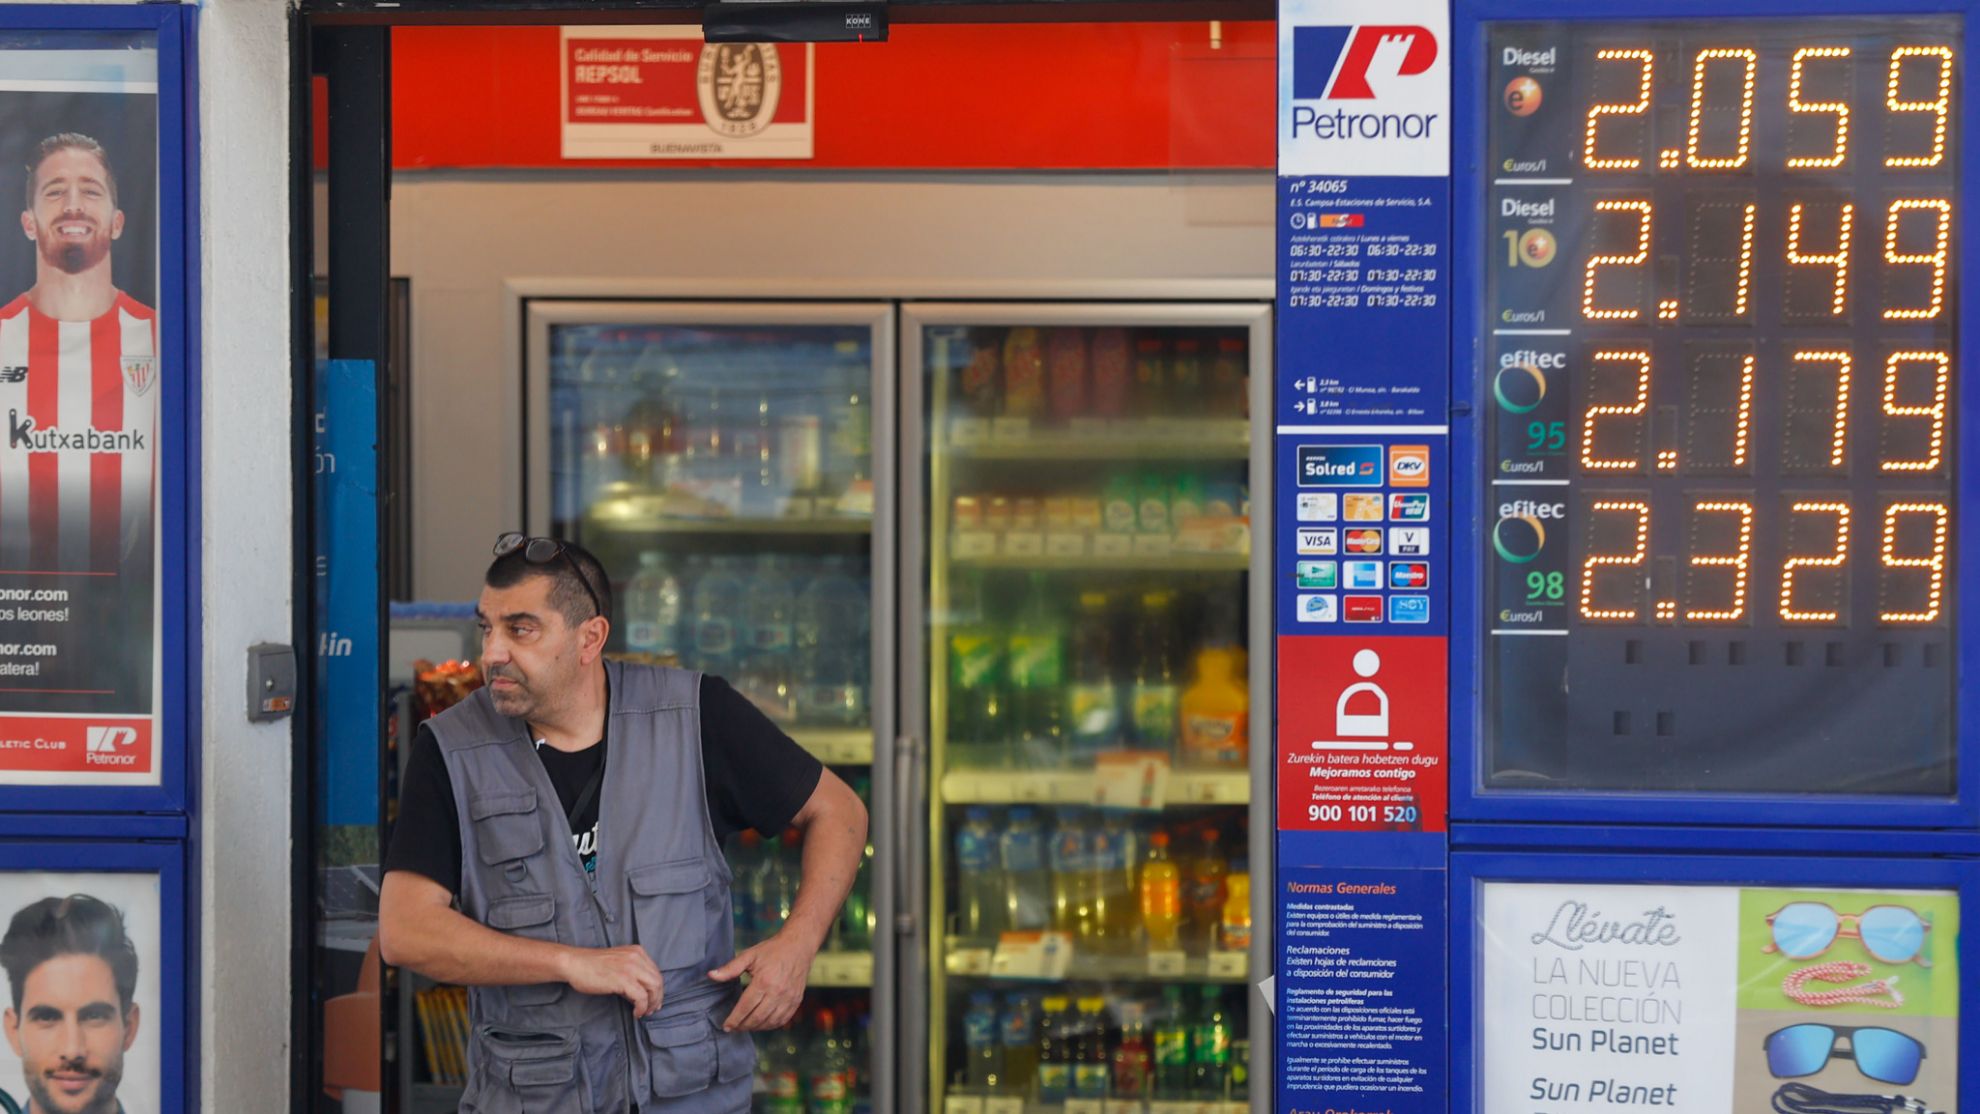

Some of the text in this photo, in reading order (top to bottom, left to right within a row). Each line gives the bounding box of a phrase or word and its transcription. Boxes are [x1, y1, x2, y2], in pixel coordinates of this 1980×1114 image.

[846, 17, 870, 25] KONE
[574, 47, 693, 62] Calidad de Servicio
[1503, 47, 1556, 65] Diesel
[575, 65, 643, 84] REPSOL
[1584, 46, 1952, 168] 2.059
[1291, 106, 1438, 139] Petronor
[1307, 180, 1348, 193] 34065
[1501, 197, 1555, 217] Diesel
[1582, 199, 1951, 319] 2.149
[1499, 350, 1567, 369] efitec
[1581, 351, 1949, 471] 2.179
[9, 408, 145, 450] Kutxabank
[1527, 421, 1567, 449] 95
[1305, 461, 1356, 476] Solred
[1397, 461, 1423, 471] DKV
[1498, 500, 1566, 519] efitec
[1304, 535, 1332, 547] VISA
[1580, 502, 1948, 622] 2.329
[1526, 571, 1565, 600] 98
[17, 606, 69, 622] leones!
[86, 752, 137, 764] Petronor
[1287, 753, 1439, 768] Zurekin batera hobetzen dugu
[1309, 766, 1416, 780] Mejoramos contigo
[1312, 793, 1342, 801] Teléfono
[1342, 793, 1352, 801] de
[1352, 793, 1382, 802] atención
[1383, 794, 1391, 802] al
[1308, 804, 1417, 823] 900 101 520
[1287, 882, 1397, 895] Normas Generales
[1286, 902, 1354, 911] Medidas contrastadas
[1531, 900, 1682, 951] Llévate
[1286, 945, 1350, 956] Reclamaciones
[1286, 957, 1313, 966] Existen
[1314, 957, 1335, 968] hojas
[1336, 957, 1347, 967] de
[1293, 968, 1395, 979] disposición del consumidor
[1533, 957, 1681, 989] LA NUEVA
[1286, 987, 1325, 997] Reglamento
[1325, 988, 1335, 996] de
[1335, 988, 1367, 998] seguridad
[1367, 990, 1383, 999] para
[1532, 991, 1682, 1025] COLECCIÓN
[1532, 1027, 1680, 1056] Sun Planet
[1530, 1077, 1678, 1106] Sun Planet
